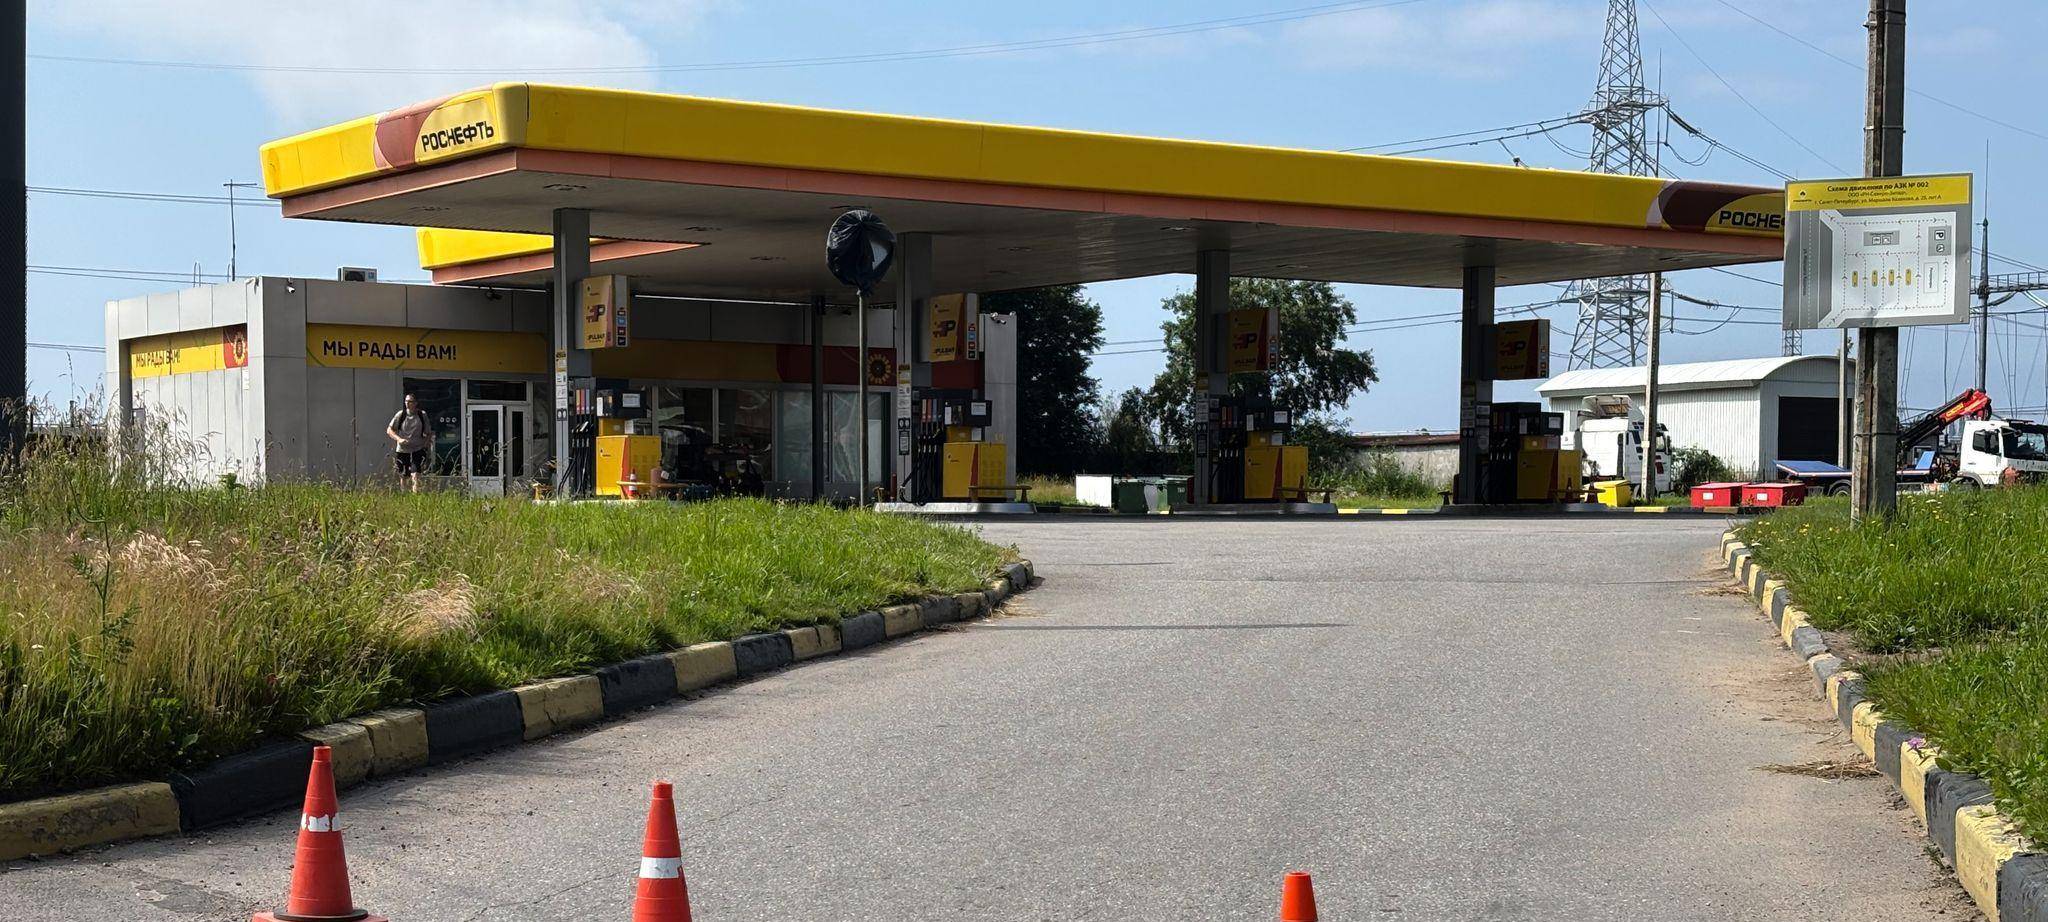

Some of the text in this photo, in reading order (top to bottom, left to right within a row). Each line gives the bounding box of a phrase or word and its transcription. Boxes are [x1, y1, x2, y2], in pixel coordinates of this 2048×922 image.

[421, 121, 494, 152] РОСНЕФТЬ
[1849, 184, 1883, 192] движения
[136, 352, 146, 368] МЫ
[147, 350, 165, 368] РАДЫ
[323, 340, 457, 360] МЫ РАДЫ ВАМ!
